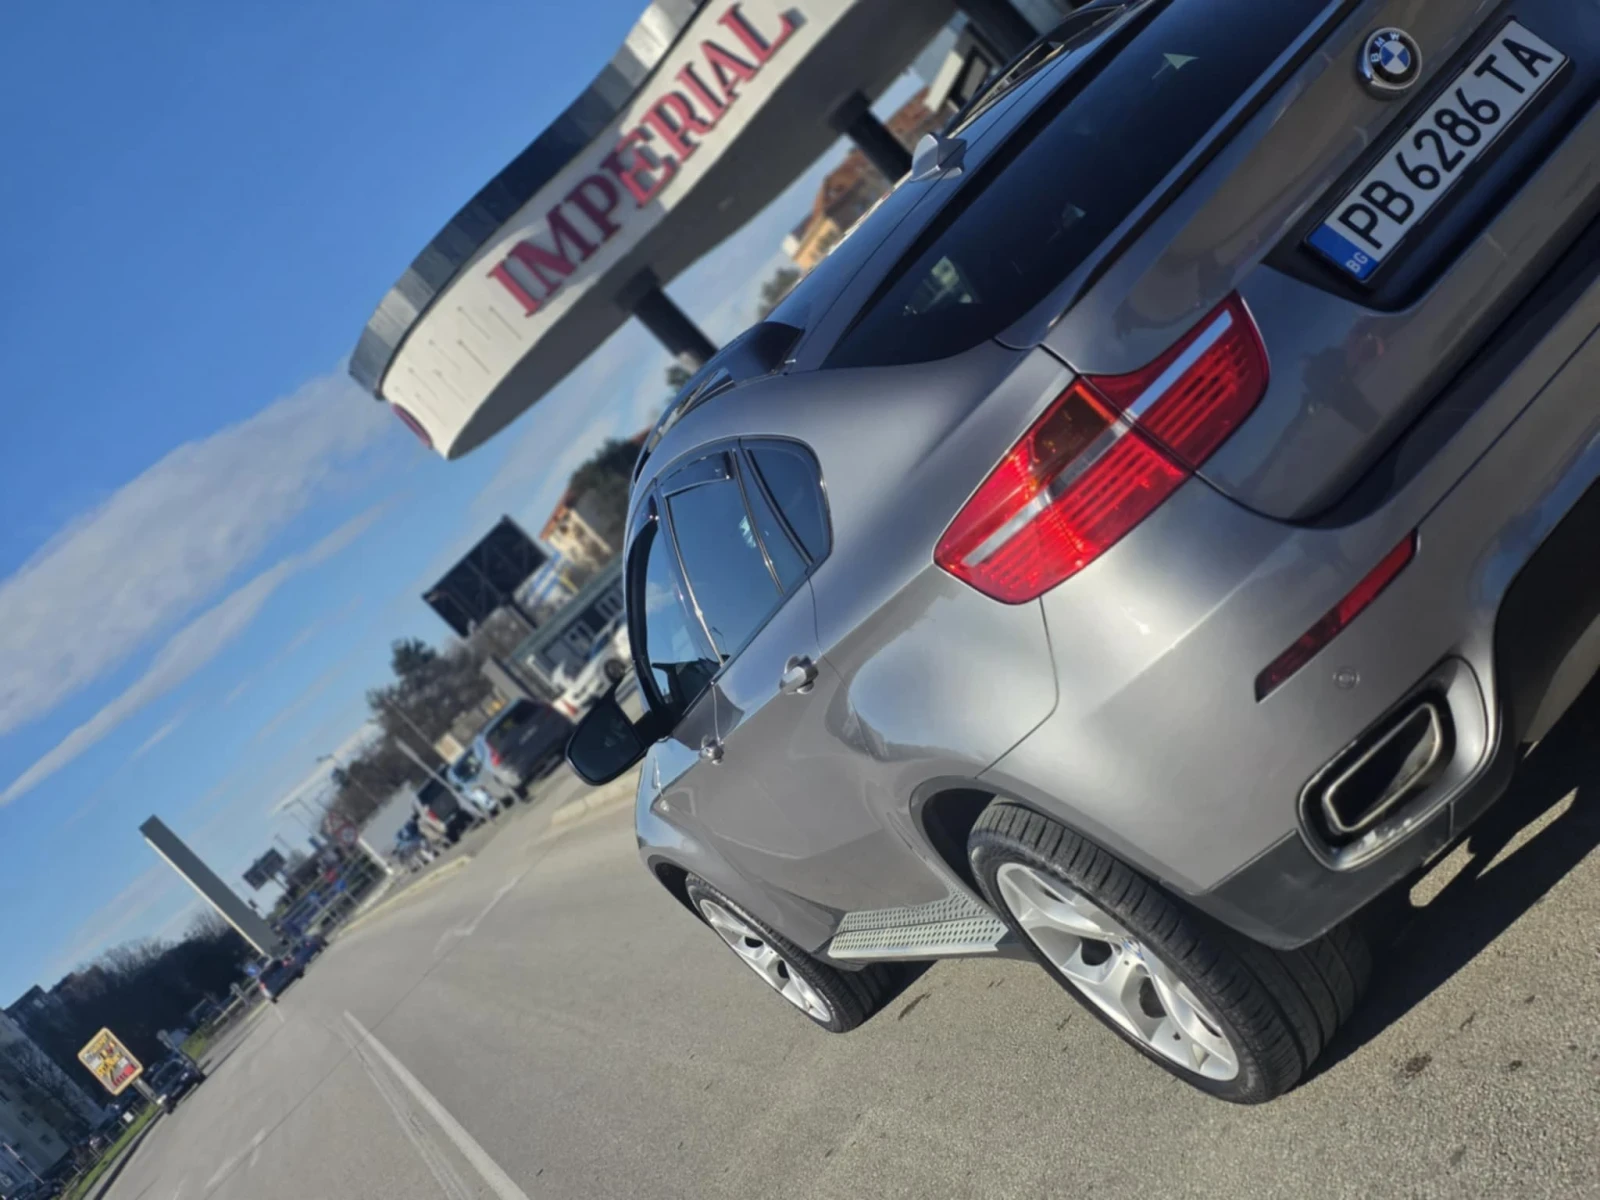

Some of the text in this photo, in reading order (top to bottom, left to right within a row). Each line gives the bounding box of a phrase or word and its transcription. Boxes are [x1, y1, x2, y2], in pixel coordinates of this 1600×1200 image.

[1371, 32, 1400, 62] BMW
[487, 3, 807, 317] IMPERIAL
[1338, 38, 1553, 250] PB 6286 TA
[1345, 252, 1369, 273] BG
